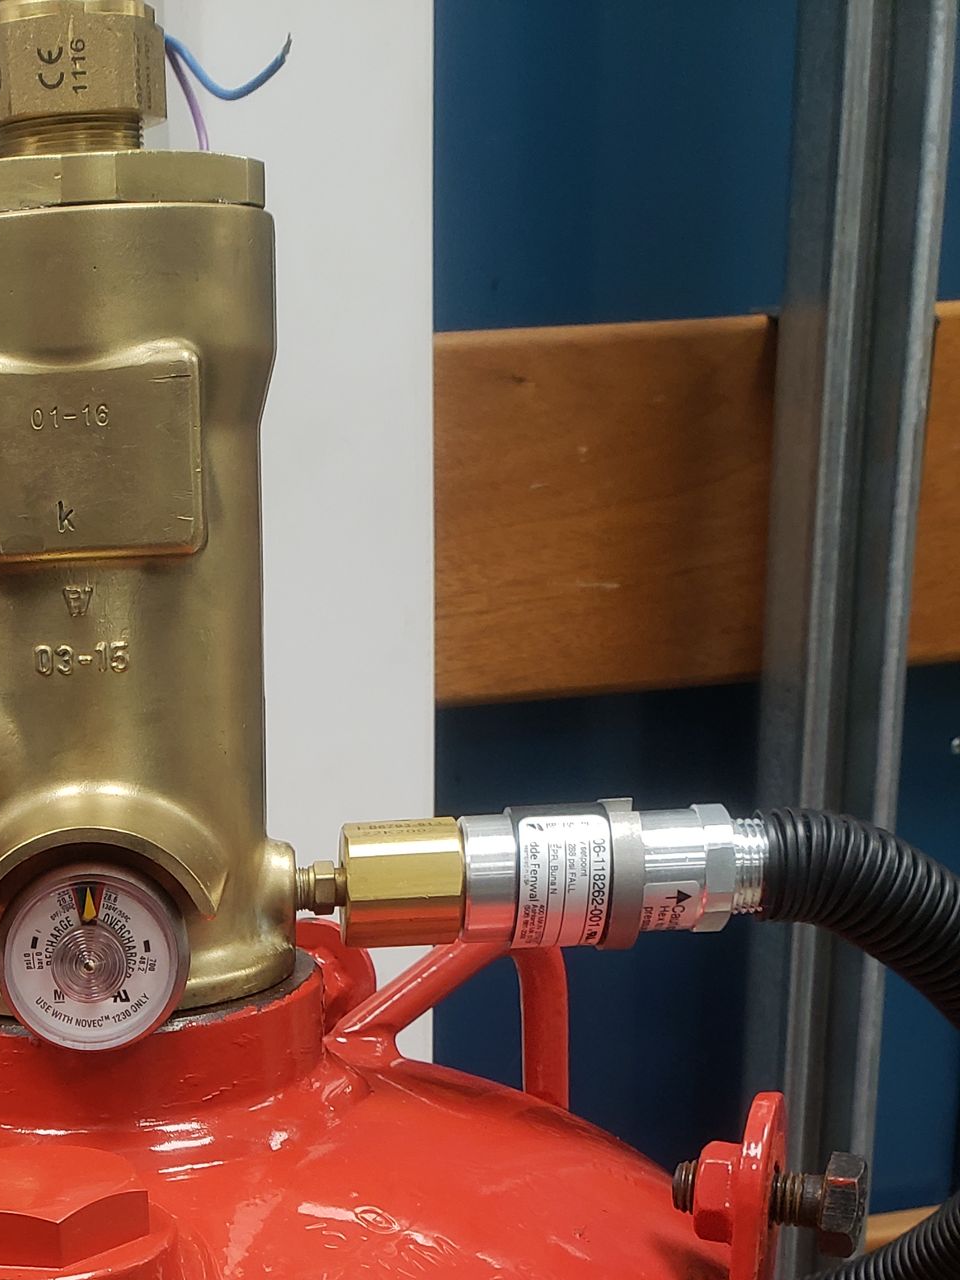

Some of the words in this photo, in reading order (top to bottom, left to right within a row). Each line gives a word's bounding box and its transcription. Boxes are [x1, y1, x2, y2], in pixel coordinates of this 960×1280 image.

[70, 38, 87, 94] 1116
[30, 403, 109, 431] 01-16
[34, 641, 129, 676] 03-15
[528, 863, 540, 902] Fenwal
[567, 872, 577, 894] FALL
[35, 996, 53, 1014] USE
[51, 1008, 73, 1025] WITH
[111, 1009, 132, 1024] 1230
[130, 992, 150, 1013] ONLY
